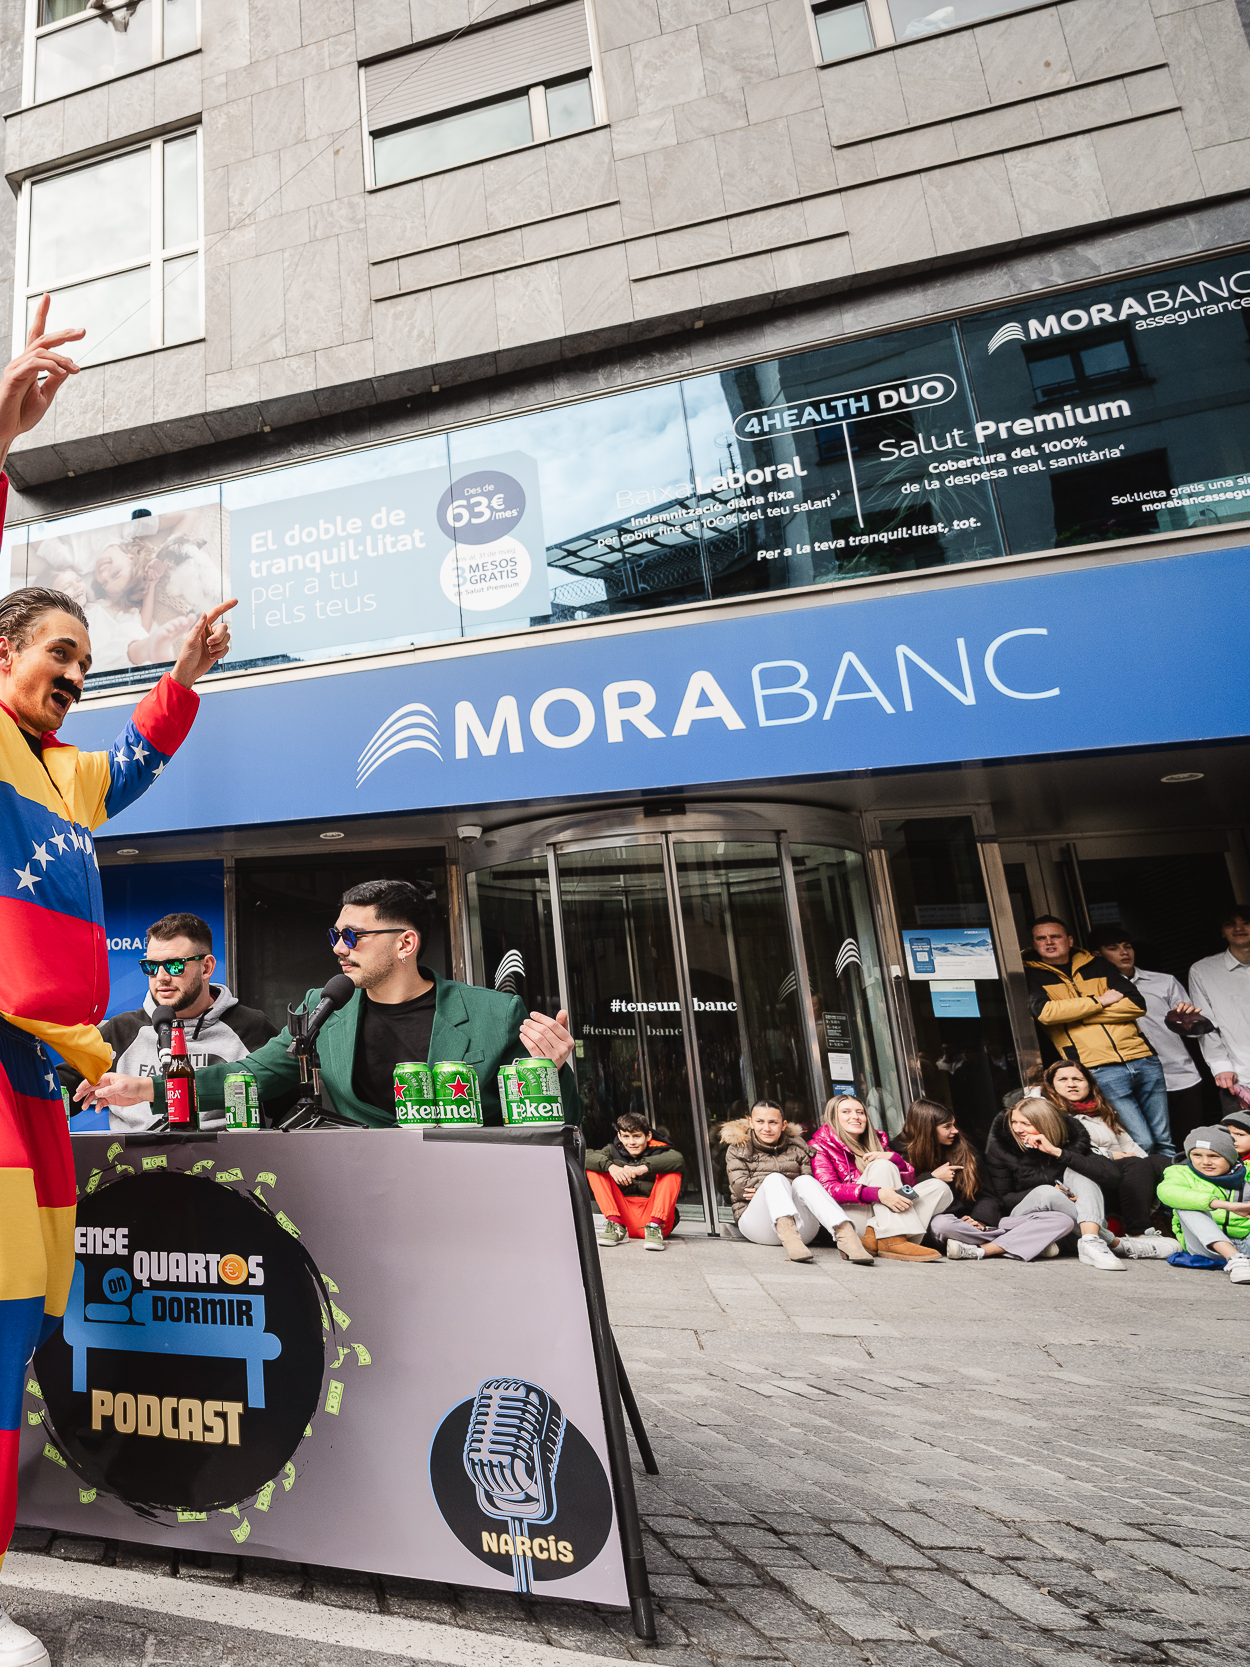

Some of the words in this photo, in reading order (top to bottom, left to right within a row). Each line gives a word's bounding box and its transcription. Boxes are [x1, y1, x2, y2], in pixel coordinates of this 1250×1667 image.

[744, 394, 870, 434] 4HEALTH
[878, 381, 944, 409] DUO
[878, 428, 968, 462] Salut
[974, 399, 1132, 444] Premium
[928, 452, 1007, 474] Cobertura
[1011, 444, 1039, 459] del
[1041, 436, 1088, 454] 100%
[464, 487, 482, 495] Des
[483, 484, 495, 492] de
[616, 482, 691, 510] Baixa
[695, 456, 808, 495] Laboral
[901, 481, 921, 494] de
[924, 478, 941, 491] la
[945, 468, 1008, 487] despesa
[1012, 460, 1047, 475] real
[1169, 483, 1206, 498] gratis
[1208, 479, 1234, 490] una
[630, 502, 722, 528] Indemnització
[726, 494, 764, 511] diària
[768, 488, 795, 503] fixa
[251, 530, 277, 553] El
[284, 515, 363, 547] doble
[371, 506, 406, 530] de
[597, 535, 619, 550] per
[621, 527, 656, 543] cobrir
[658, 525, 682, 537] fins
[685, 520, 699, 533] al
[701, 514, 739, 529] 100%
[741, 509, 764, 522] del
[766, 505, 791, 518] teu
[757, 548, 781, 561] Per
[783, 546, 793, 557] a
[796, 543, 811, 555] la
[814, 537, 845, 552] teva
[953, 516, 982, 531] tot.
[468, 557, 518, 574] MESOS
[469, 568, 518, 585] GRATIS
[252, 580, 295, 609] per
[304, 577, 319, 595] a
[329, 570, 358, 590] tu
[465, 587, 484, 595] Salut
[252, 610, 256, 629] i
[265, 603, 306, 627] els
[315, 593, 377, 619] teus
[454, 628, 1061, 760] MORABANC
[610, 998, 681, 1013] #tensun
[692, 997, 738, 1012] banc
[152, 1295, 254, 1327] DORMIR
[91, 1388, 245, 1447] PODCAST
